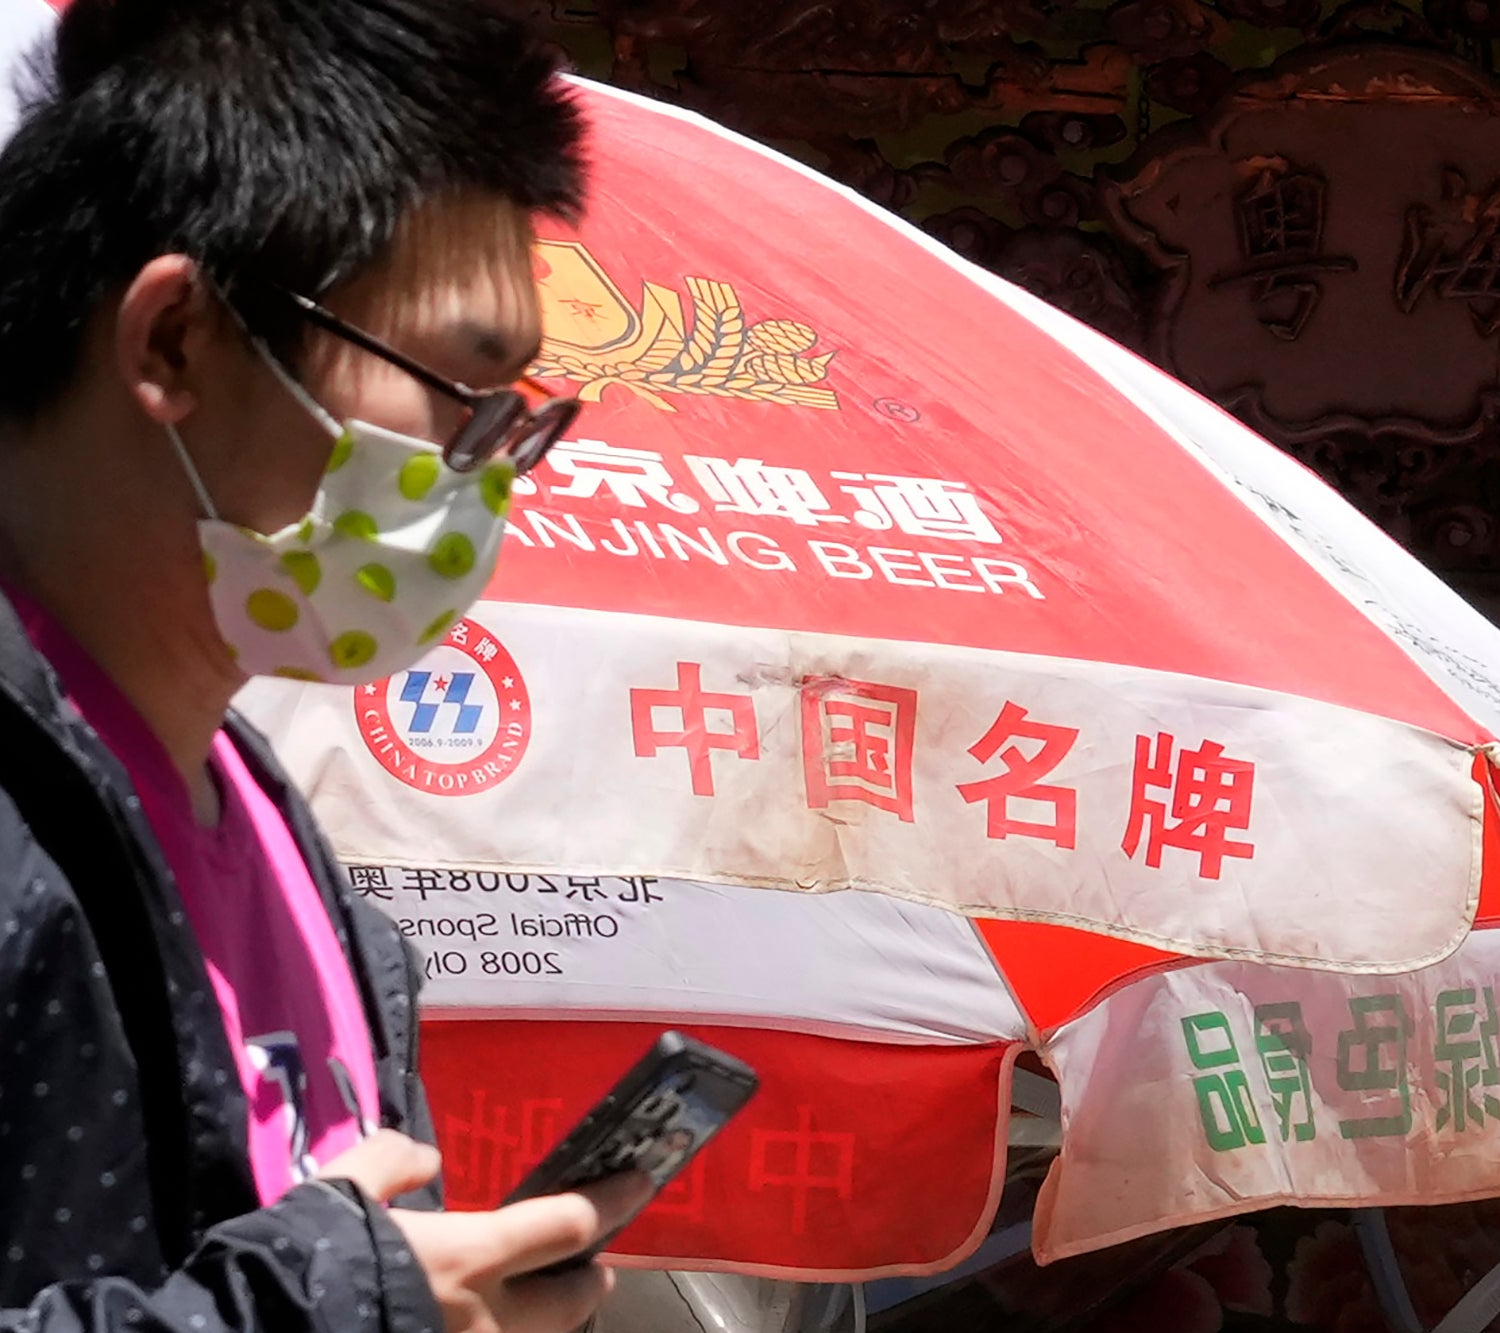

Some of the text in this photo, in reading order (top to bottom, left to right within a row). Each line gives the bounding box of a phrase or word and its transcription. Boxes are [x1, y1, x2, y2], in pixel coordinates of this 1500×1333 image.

[512, 438, 1002, 546] 京啤酒
[812, 538, 1046, 600] BEER
[365, 708, 524, 790] CHINA TOP BRAND
[629, 661, 1255, 880] 中国名牌
